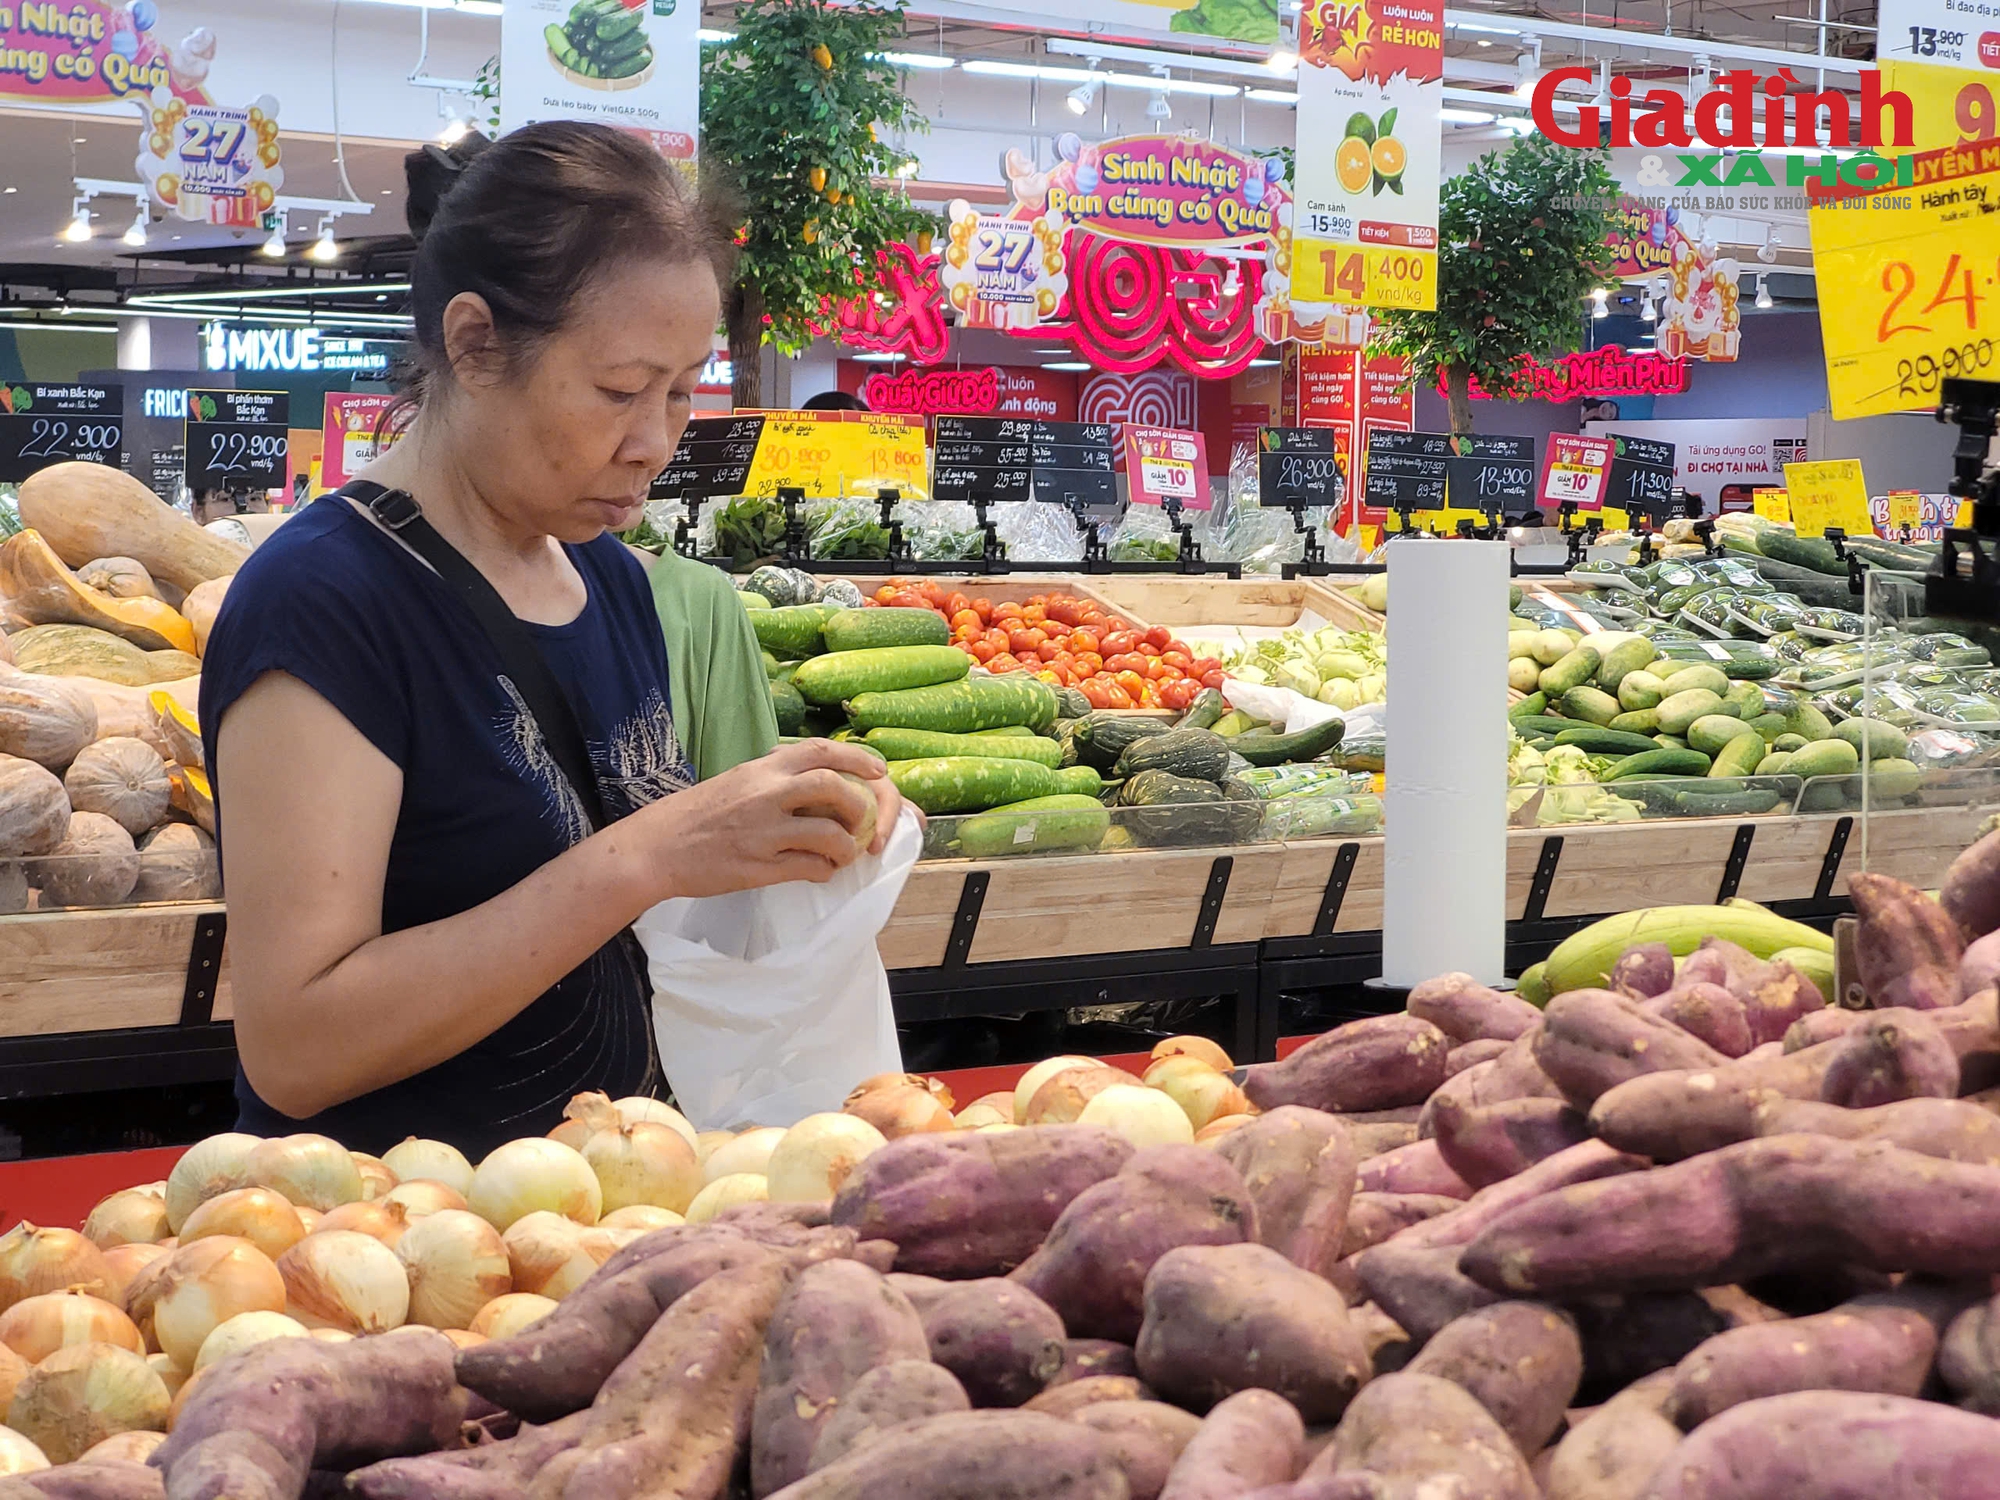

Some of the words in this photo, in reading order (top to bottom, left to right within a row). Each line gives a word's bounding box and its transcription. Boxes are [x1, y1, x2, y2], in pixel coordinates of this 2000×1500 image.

[1382, 5, 1408, 18] LUÔN
[1409, 8, 1434, 22] LUÔN
[1957, 1, 1974, 13] đao
[19, 2, 105, 48] Nhật
[1319, 3, 1362, 40] GIÁ
[1381, 20, 1404, 45] RẺ
[1404, 28, 1441, 50] HƠN
[53, 46, 96, 81] có
[101, 53, 170, 96] Quà
[562, 98, 575, 109] leo
[577, 100, 598, 113] baby
[637, 108, 660, 119] 500g
[180, 117, 246, 165] 27
[1101, 151, 1165, 187] Sinh
[1169, 156, 1242, 198] Nhật
[1307, 200, 1326, 212] Cam
[1921, 188, 1960, 210] Hành
[1963, 183, 1988, 202] tây
[1046, 187, 1102, 224] Bạn
[1107, 187, 1175, 228] cũng
[1178, 193, 1213, 223] có
[1215, 197, 1273, 237] Quà
[1004, 220, 1030, 232] TRÌNH
[975, 229, 1035, 274] 27
[1609, 236, 1632, 262] có
[1634, 240, 1672, 271] Quà
[977, 271, 1017, 292] NĂM
[229, 327, 321, 371] MIXUE
[1008, 375, 1034, 391] luôn
[1326, 383, 1343, 394] ngày
[1337, 371, 1352, 380] hơn
[47, 387, 69, 398] xanh
[1311, 394, 1329, 405] cùng
[1370, 394, 1387, 405] cùng
[1024, 397, 1057, 416] động
[18, 418, 121, 458] 22.900
[1688, 444, 1701, 455] Tải
[1703, 444, 1720, 456] ứng
[1722, 445, 1746, 457] dụng
[1748, 445, 1767, 455] GO!
[205, 433, 288, 471] 22.900
[1276, 455, 1336, 490] 26.900
[1473, 466, 1533, 496] 13.900
[1687, 462, 1699, 473] ĐI
[1701, 461, 1725, 475] CHỢ
[1726, 462, 1743, 475] TẠI
[1744, 460, 1769, 473] NHÀ
[1625, 469, 1672, 498] 11.300
